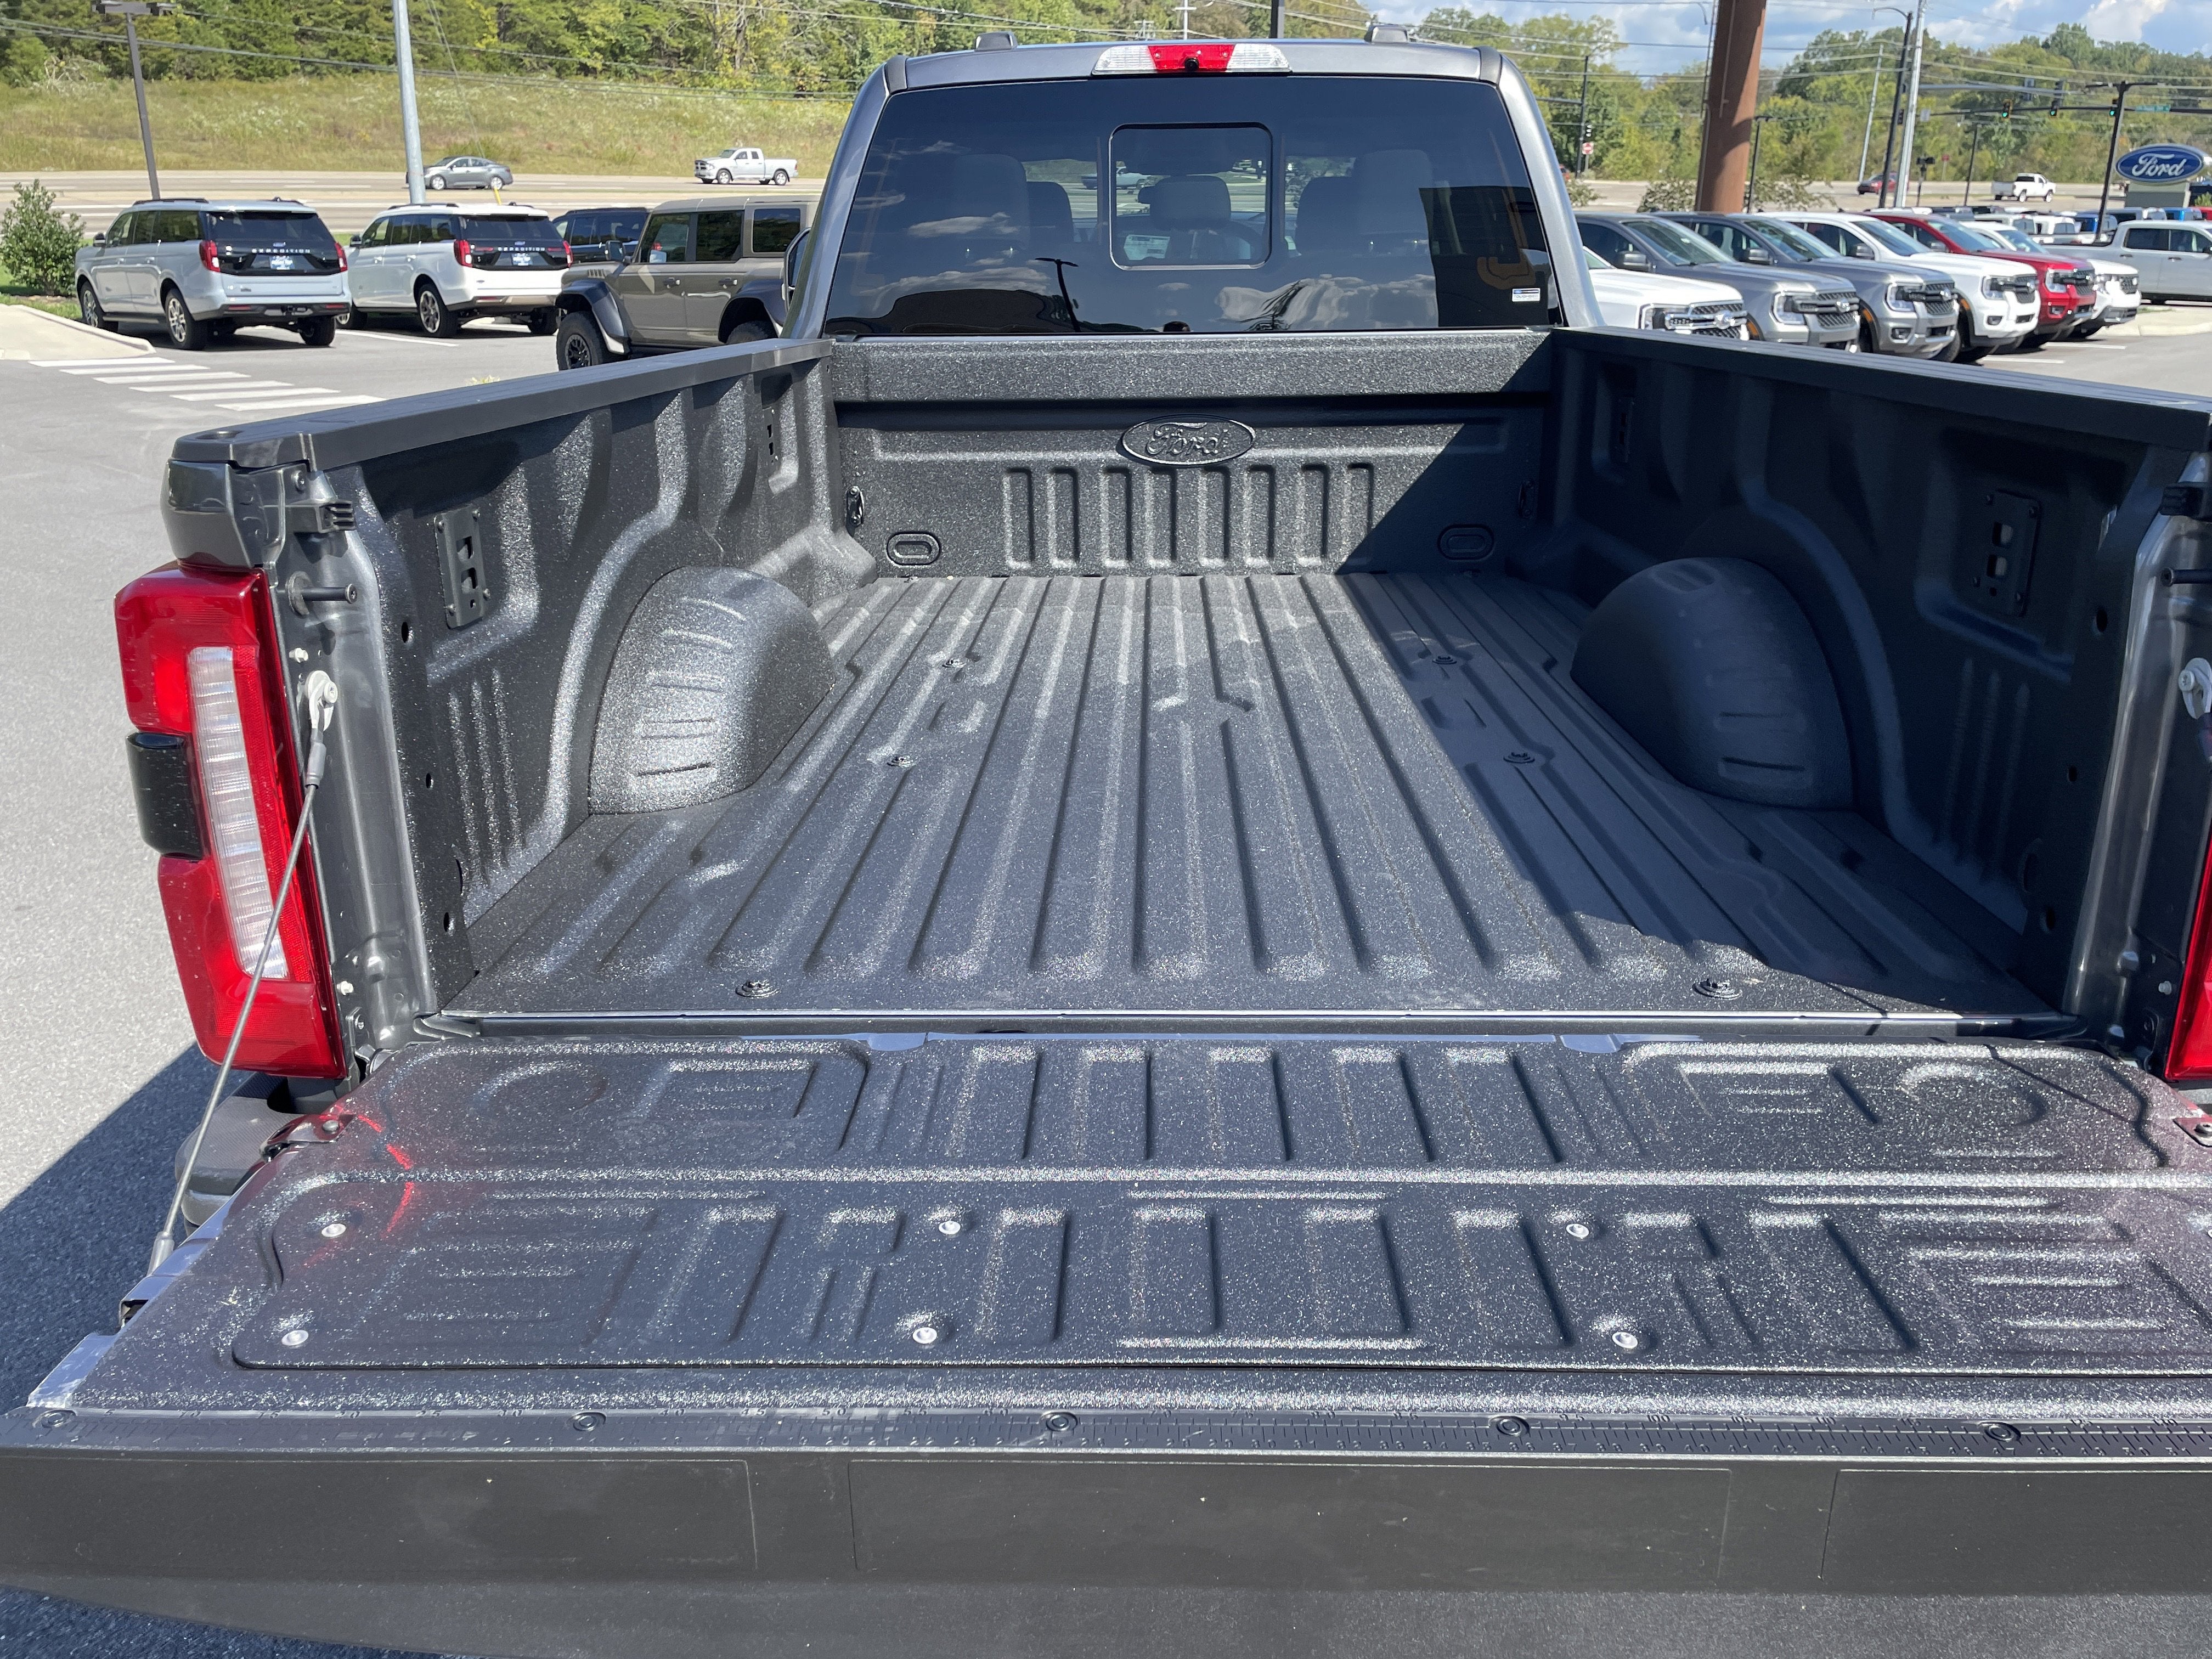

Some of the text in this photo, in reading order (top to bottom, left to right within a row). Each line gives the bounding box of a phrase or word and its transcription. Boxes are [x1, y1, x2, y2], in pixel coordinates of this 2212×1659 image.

[2132, 153, 2187, 177] Ford
[1146, 422, 1228, 456] Ford
[660, 1408, 685, 1417] 40
[741, 1408, 766, 1416] 45
[821, 1408, 847, 1416] 50
[825, 1436, 851, 1446] 20
[867, 1436, 890, 1446] 21
[910, 1436, 935, 1446] 22
[952, 1436, 978, 1447] 23
[1294, 1439, 1316, 1449] 31
[1379, 1440, 1406, 1450] 33
[1423, 1440, 1448, 1451] 34
[1465, 1441, 1492, 1451] 35
[1553, 1442, 1578, 1452] 37
[1684, 1443, 1711, 1453] 40
[1729, 1443, 1752, 1454] 41
[1772, 1444, 1798, 1454] 42
[1860, 1446, 1887, 1455] 44
[1904, 1446, 1931, 1455] 45
[1992, 1447, 2016, 1457] 47
[2121, 1447, 2151, 1457] 50
[2164, 1447, 2192, 1457] 51
